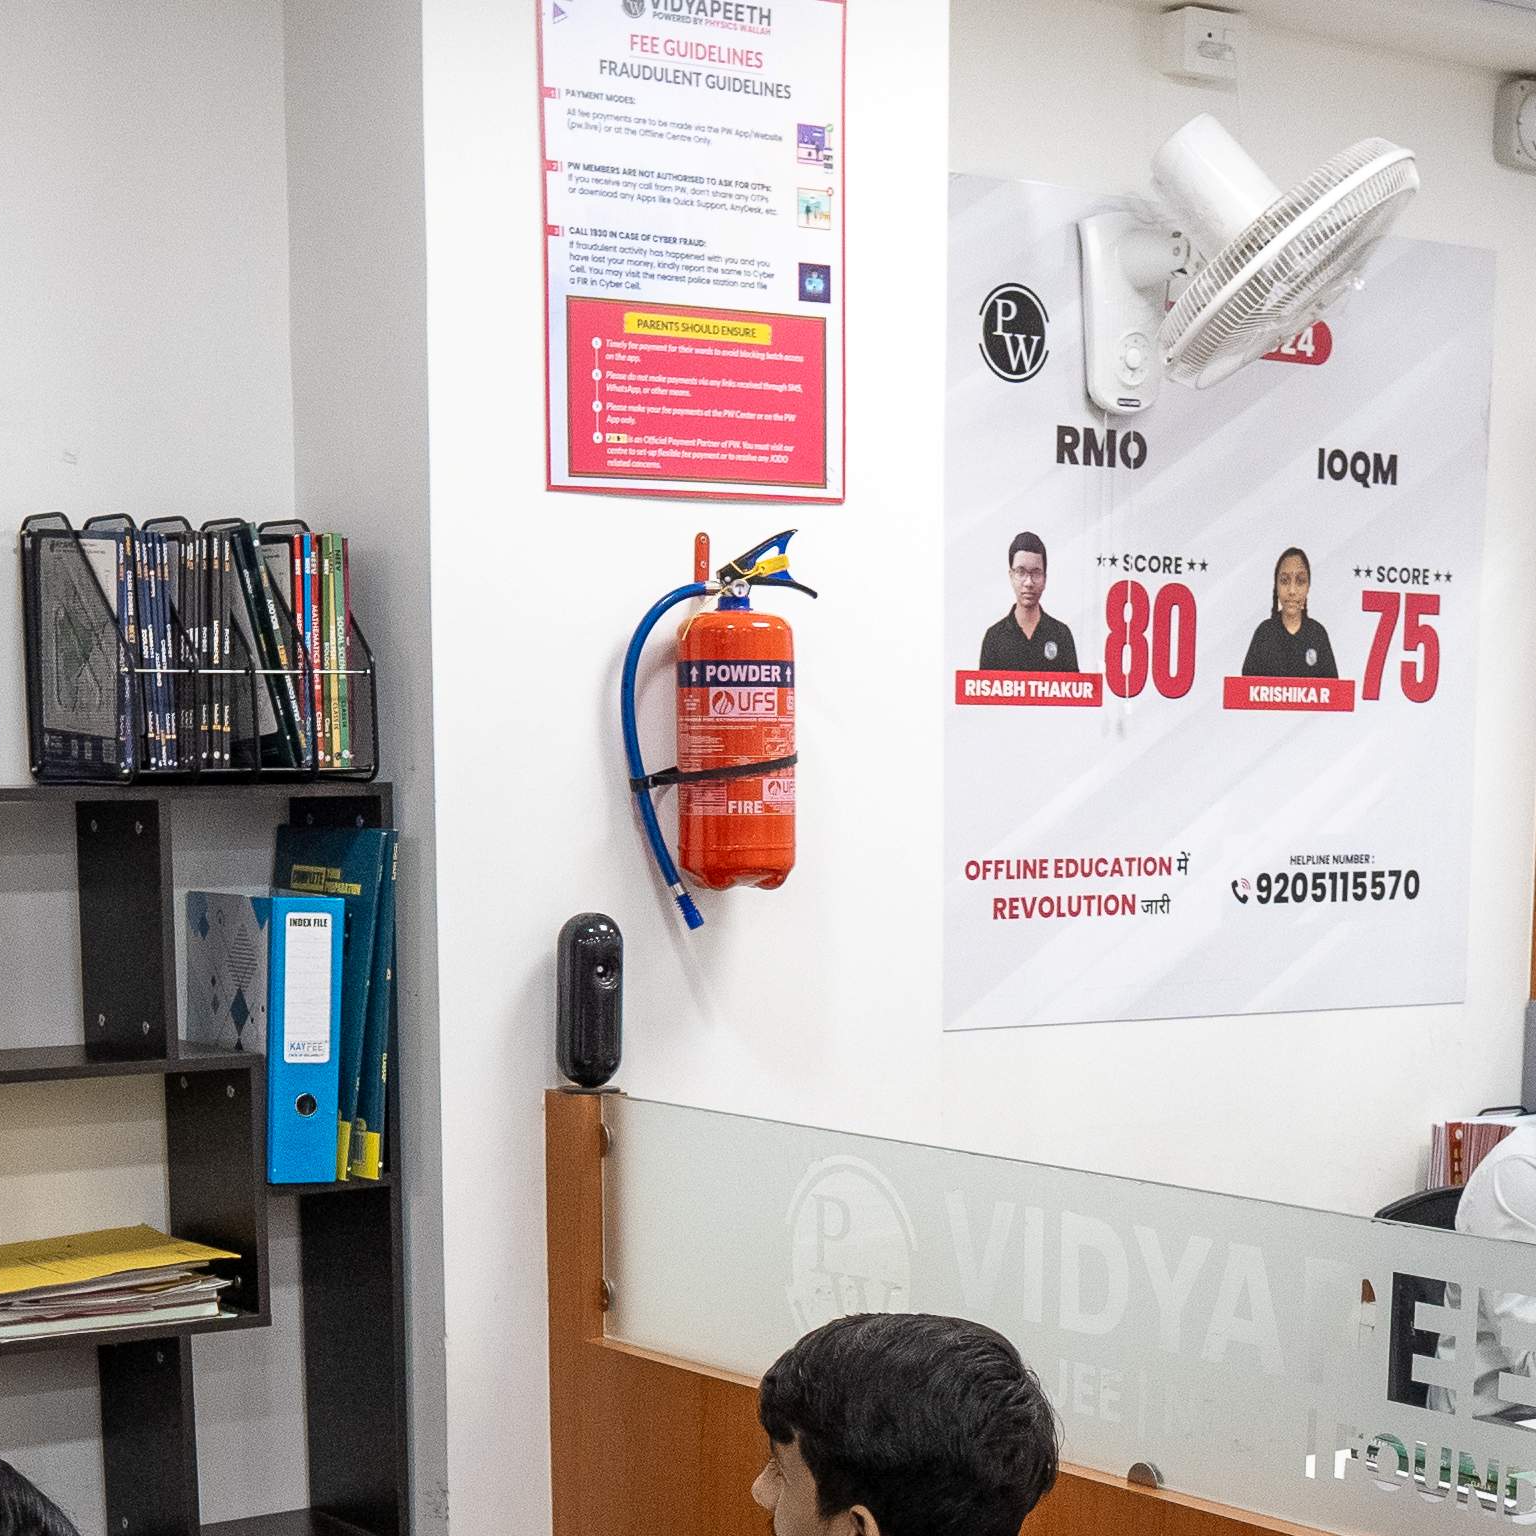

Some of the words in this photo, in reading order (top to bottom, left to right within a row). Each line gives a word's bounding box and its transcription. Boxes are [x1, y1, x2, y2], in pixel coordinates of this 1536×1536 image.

[652, 11, 691, 24] POWERED
[692, 17, 703, 25] BY
[704, 19, 737, 31] PHYSICS
[740, 25, 771, 35] WALLAH
[629, 34, 660, 54] FEE
[664, 39, 764, 69] GUIDELINES
[599, 59, 701, 88] FRAUDULENT
[705, 74, 792, 100] GUIDELINES
[565, 88, 604, 100] PAYMENT
[567, 161, 580, 170] PW
[582, 163, 620, 174] MEMBERS
[622, 168, 637, 176] ARE
[638, 170, 655, 178] NOT
[735, 180, 749, 189] FOR
[569, 226, 588, 236] CALL
[619, 231, 639, 241] CASE
[640, 233, 651, 242] OF
[652, 235, 677, 244] CYBER
[637, 319, 679, 332] PARENTS
[681, 322, 720, 335] SHOULD
[721, 325, 757, 338] ENSURE
[1056, 425, 1147, 471] RMO
[1317, 447, 1399, 488] IOQM
[1123, 553, 1183, 576] SCORE
[1376, 565, 1430, 585] SCORE
[311, 604, 320, 663] MATHEMATICS
[337, 615, 345, 646] SOCIAL
[1105, 579, 1197, 700] 80
[1361, 590, 1441, 704] 75
[338, 646, 346, 680] SCIENE
[705, 664, 782, 682] POWDER
[965, 678, 1025, 698] RISABH
[1026, 680, 1094, 700] THAKUR
[1249, 685, 1317, 704] KRISHIKA
[1319, 686, 1330, 704] R
[738, 691, 775, 712] UFS
[728, 800, 763, 814] FIRE
[964, 858, 1049, 881] OFFLINE
[1053, 856, 1173, 879] EDUCATION
[1176, 851, 1192, 876] में
[1290, 854, 1330, 866] HELPLINE
[1332, 854, 1369, 864] NUMBER
[1256, 870, 1420, 904] 9205115570
[992, 894, 1136, 920] REVOLUTION
[1141, 893, 1171, 915] जारी
[289, 918, 312, 927] INDEX
[313, 918, 328, 927] FILE
